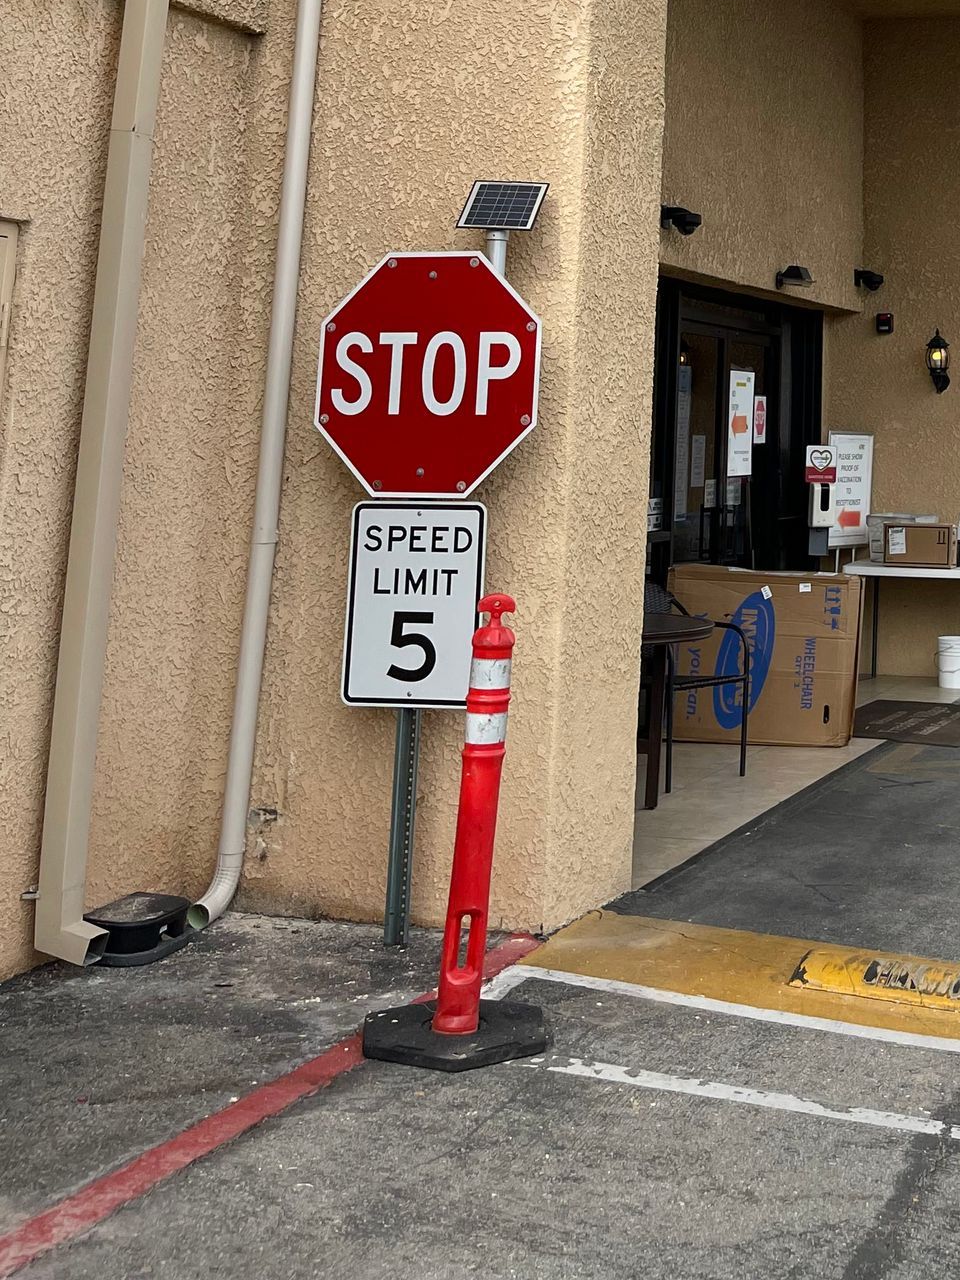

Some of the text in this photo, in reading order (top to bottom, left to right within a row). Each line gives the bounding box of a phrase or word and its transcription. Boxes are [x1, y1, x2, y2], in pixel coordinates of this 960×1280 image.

[330, 331, 522, 417] STOP
[363, 524, 473, 553] SPEED
[373, 568, 459, 597] LIMIT
[386, 611, 437, 683] 5
[795, 655, 803, 677] QTY
[800, 636, 817, 710] WHEELCHAIR
